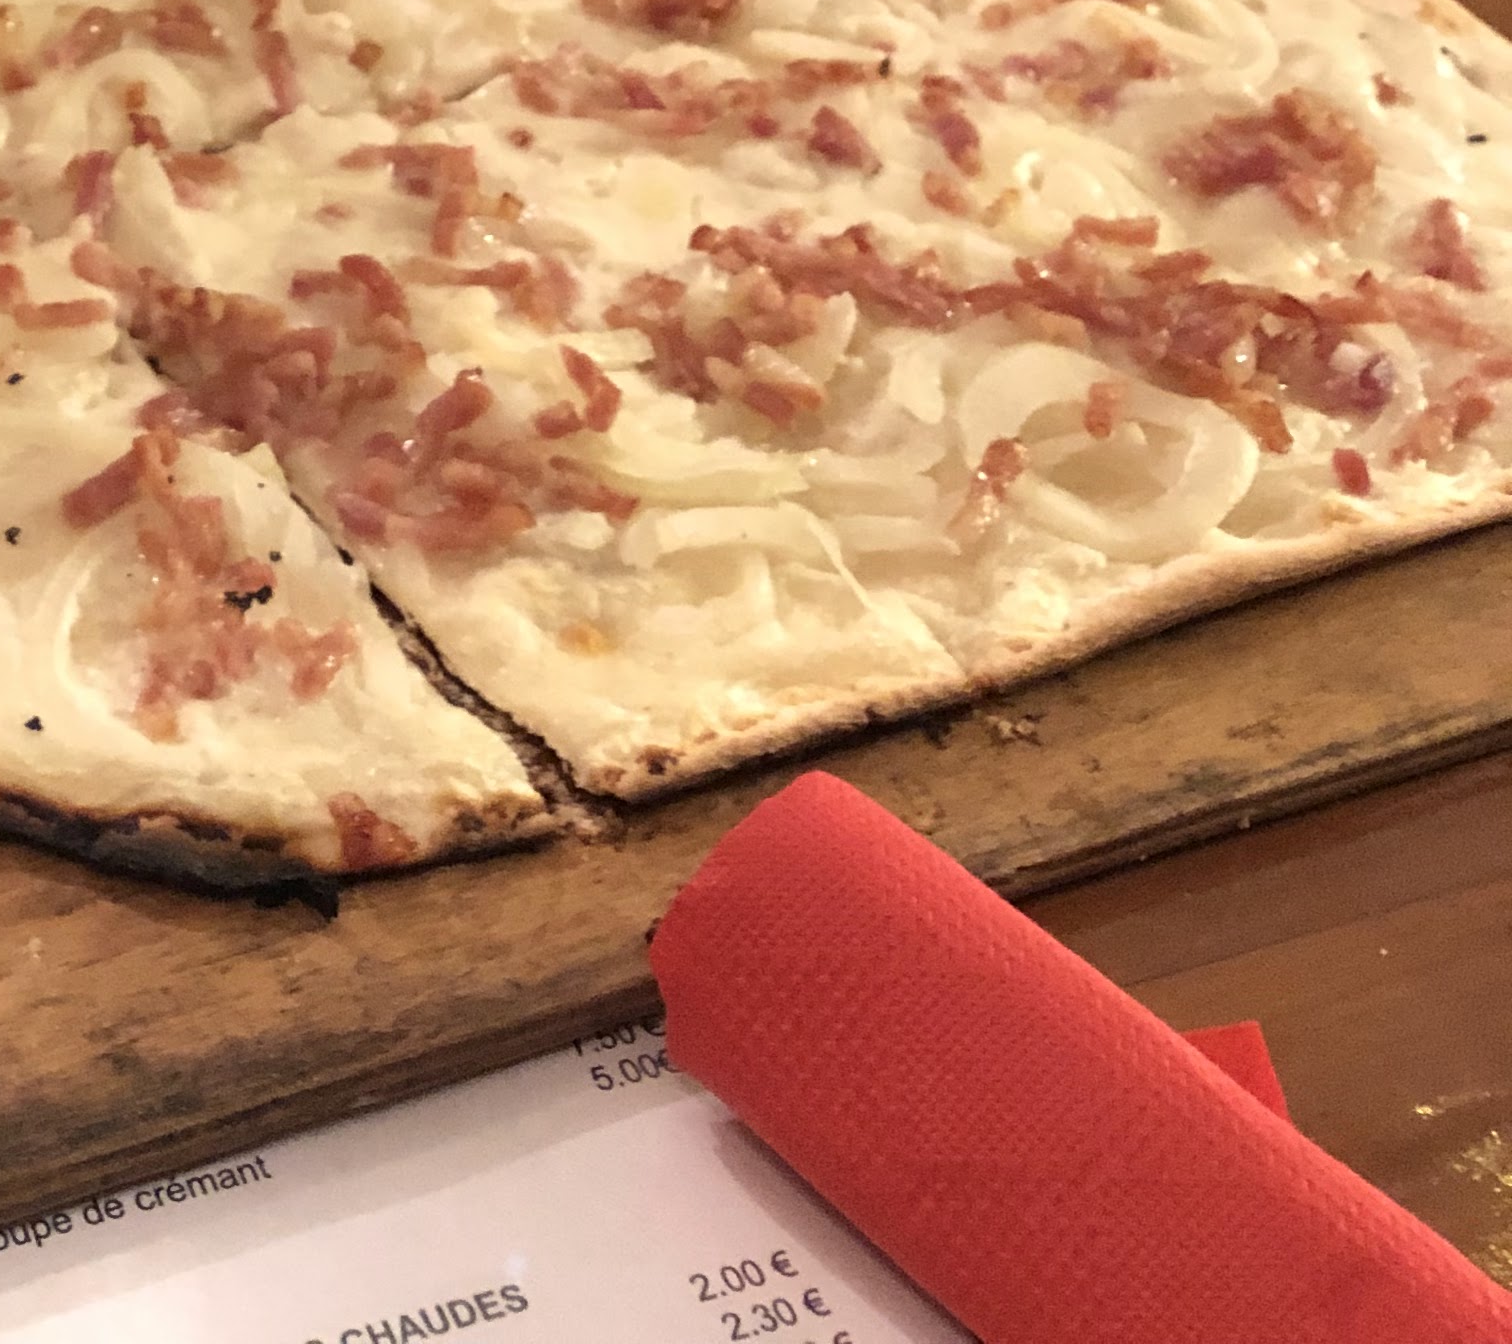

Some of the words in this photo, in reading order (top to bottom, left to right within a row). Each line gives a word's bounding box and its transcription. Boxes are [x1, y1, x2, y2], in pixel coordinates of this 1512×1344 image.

[82, 1194, 126, 1226] de
[135, 1155, 273, 1211] crémant
[689, 1259, 766, 1302] 2.00
[771, 1249, 799, 1278] €
[340, 1284, 529, 1344] CHAUDES
[721, 1298, 798, 1341] 2.30
[803, 1288, 832, 1317] €
